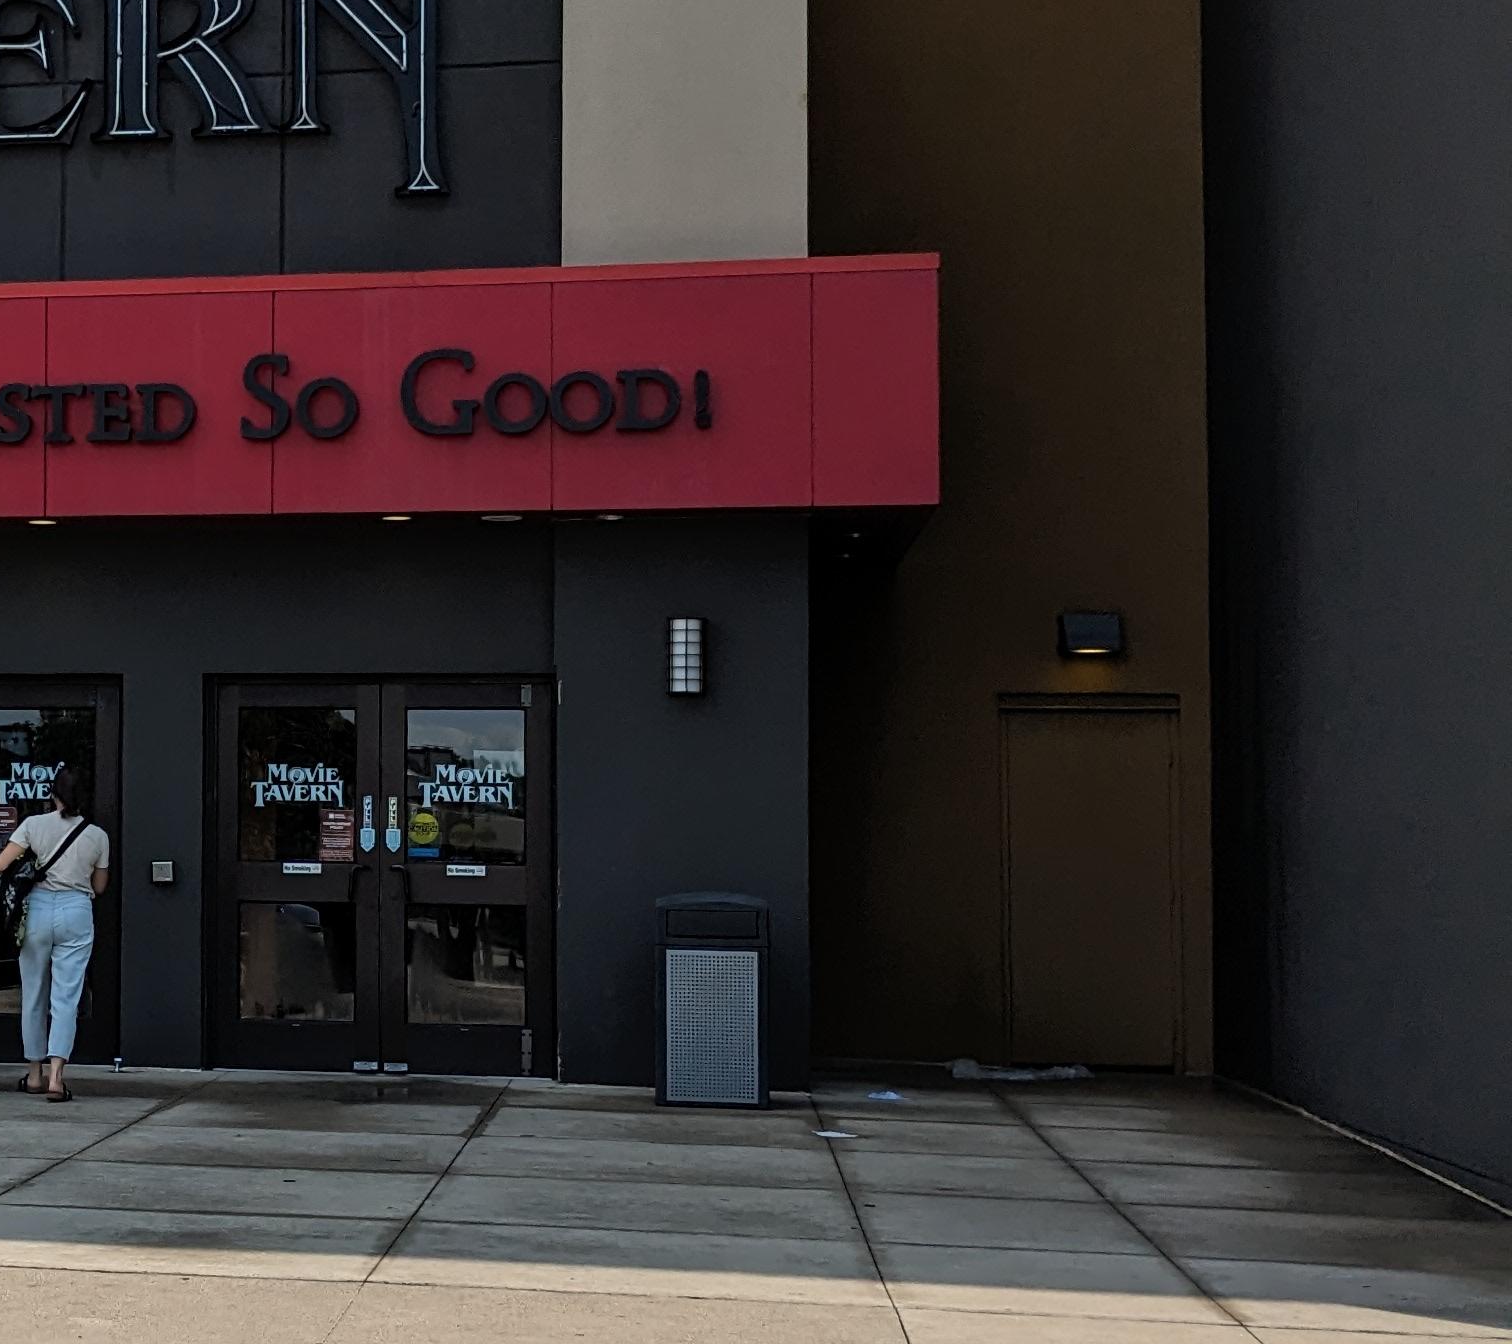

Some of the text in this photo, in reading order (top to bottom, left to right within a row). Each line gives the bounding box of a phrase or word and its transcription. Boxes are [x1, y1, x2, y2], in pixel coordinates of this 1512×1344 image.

[11, 761, 65, 782] MOV
[250, 780, 344, 807] TAVERN
[418, 782, 513, 810] TAVERN
